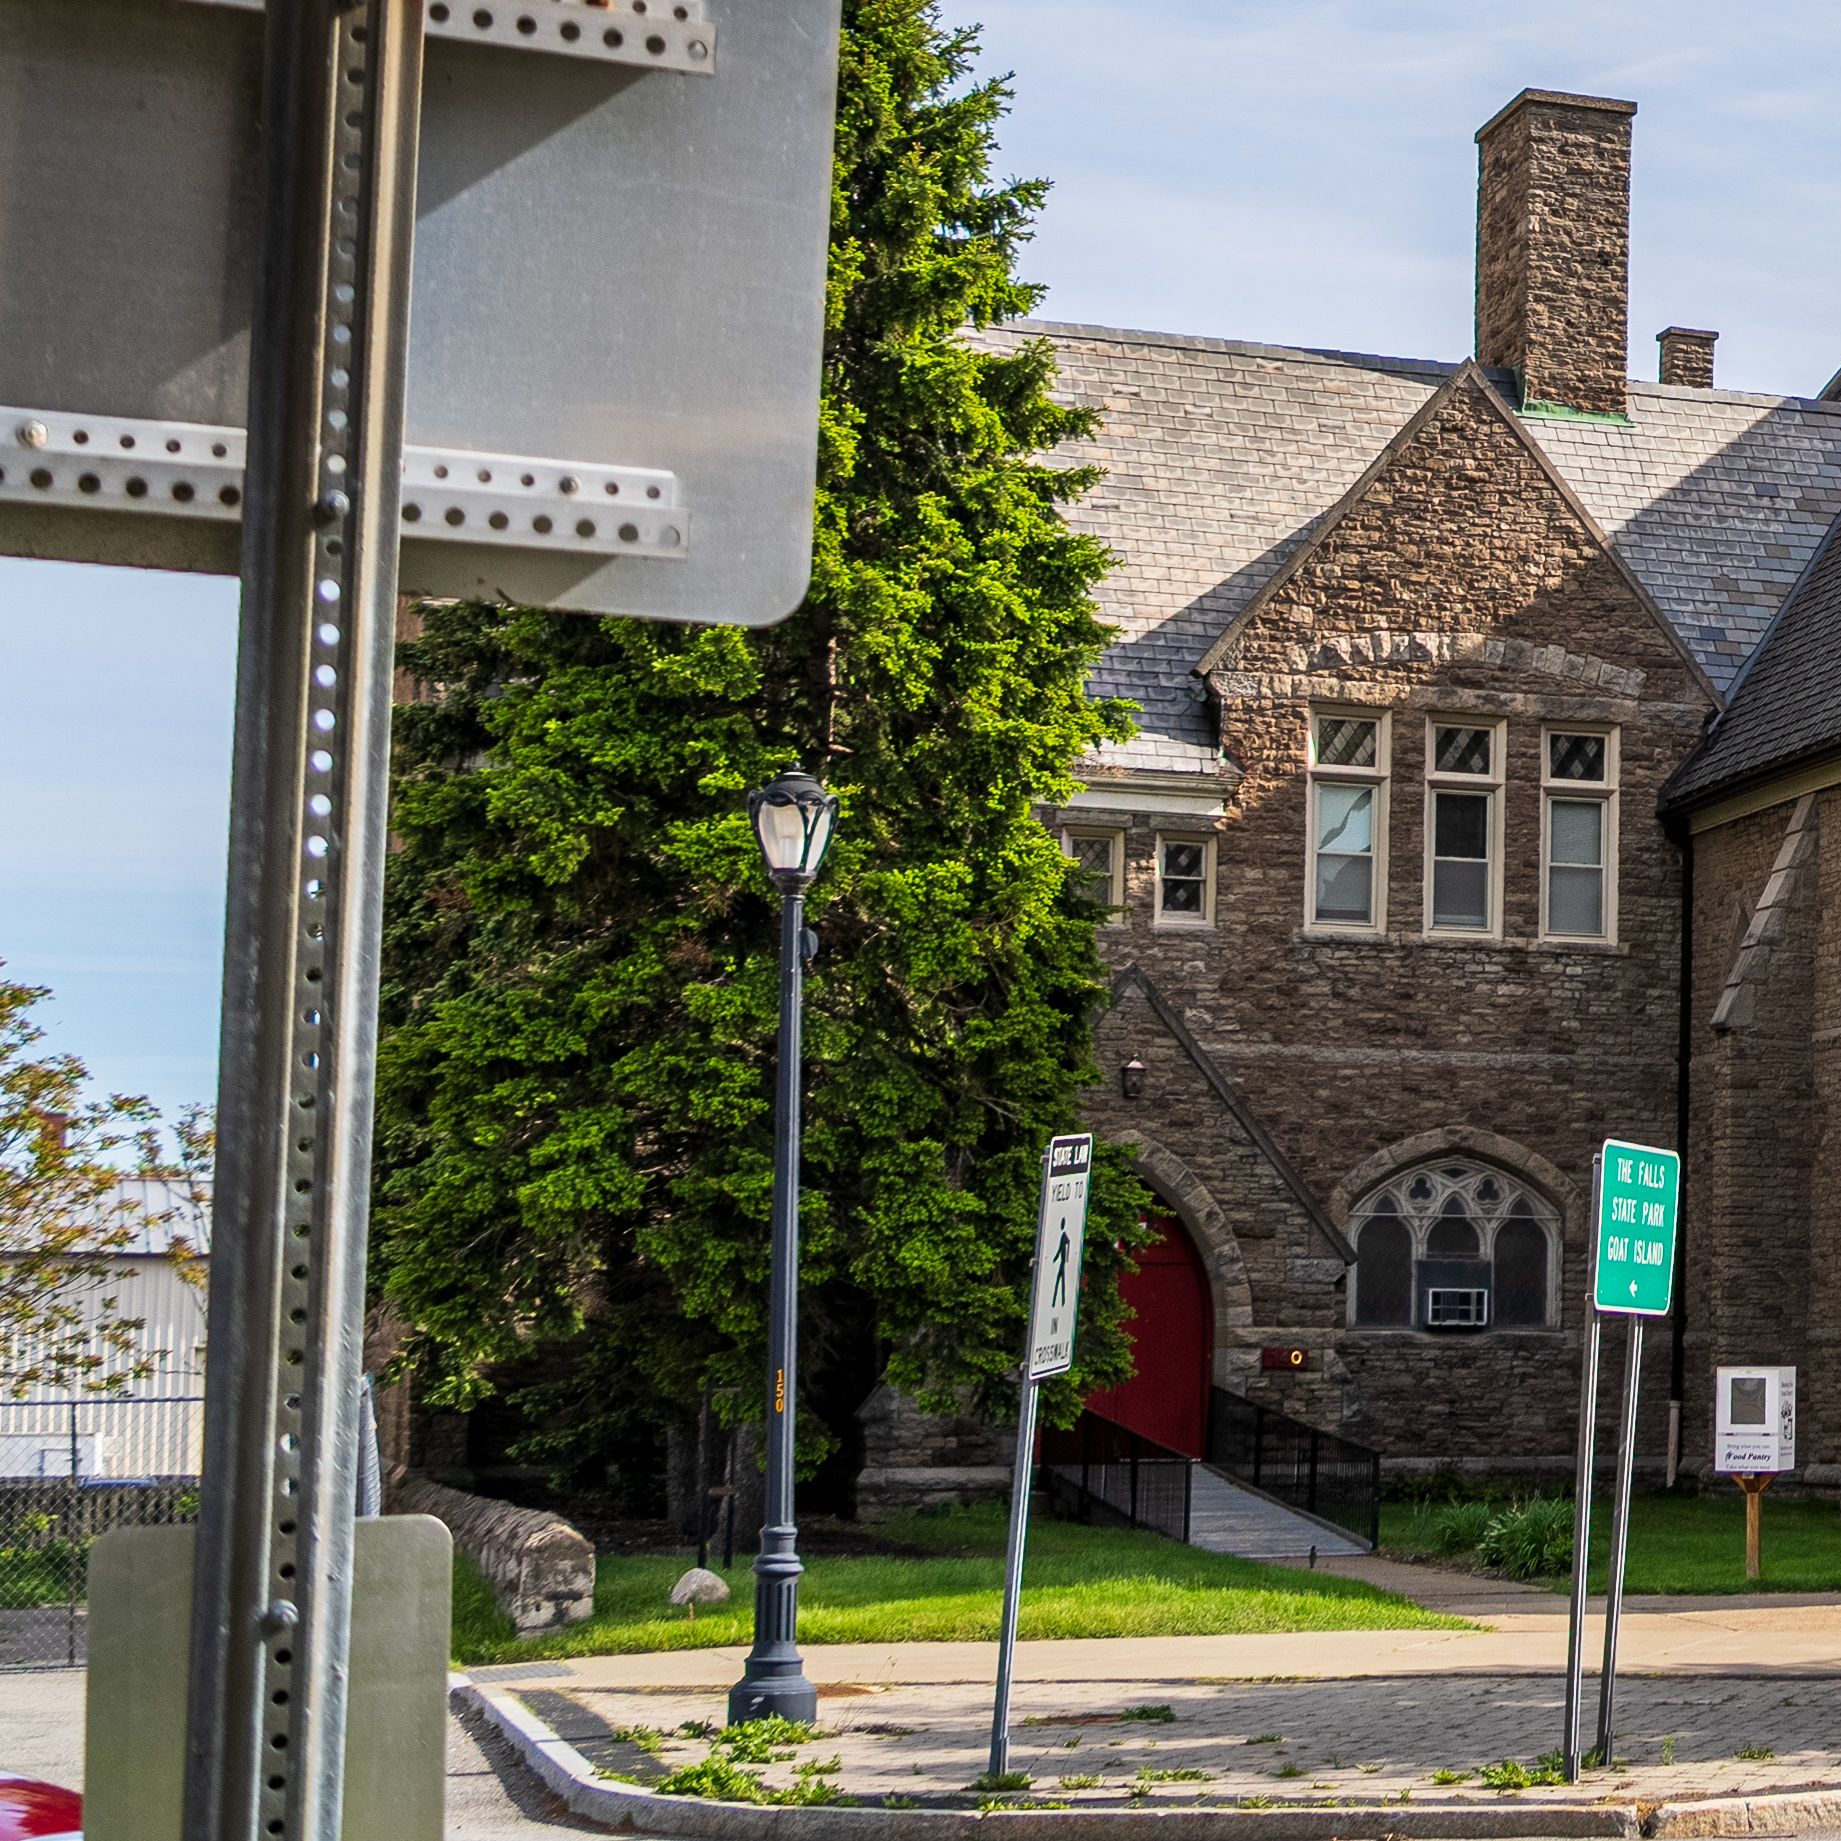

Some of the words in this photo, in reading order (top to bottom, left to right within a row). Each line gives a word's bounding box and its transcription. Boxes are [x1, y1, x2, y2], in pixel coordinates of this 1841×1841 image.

[1053, 1146, 1073, 1167] STATE
[1617, 1158, 1632, 1184] THE
[1638, 1160, 1665, 1189] FALLS
[1052, 1182, 1071, 1202] YIELD
[1075, 1181, 1084, 1200] TO
[1611, 1196, 1637, 1224] STATE
[1642, 1201, 1665, 1227] PARK
[1607, 1236, 1629, 1261] GOAT
[1633, 1239, 1664, 1266] ISLAND
[1034, 1342, 1070, 1366] CROSSWALK
[775, 1369, 784, 1413] 150
[1725, 1450, 1747, 1462] Food
[1748, 1452, 1772, 1463] Pantry
